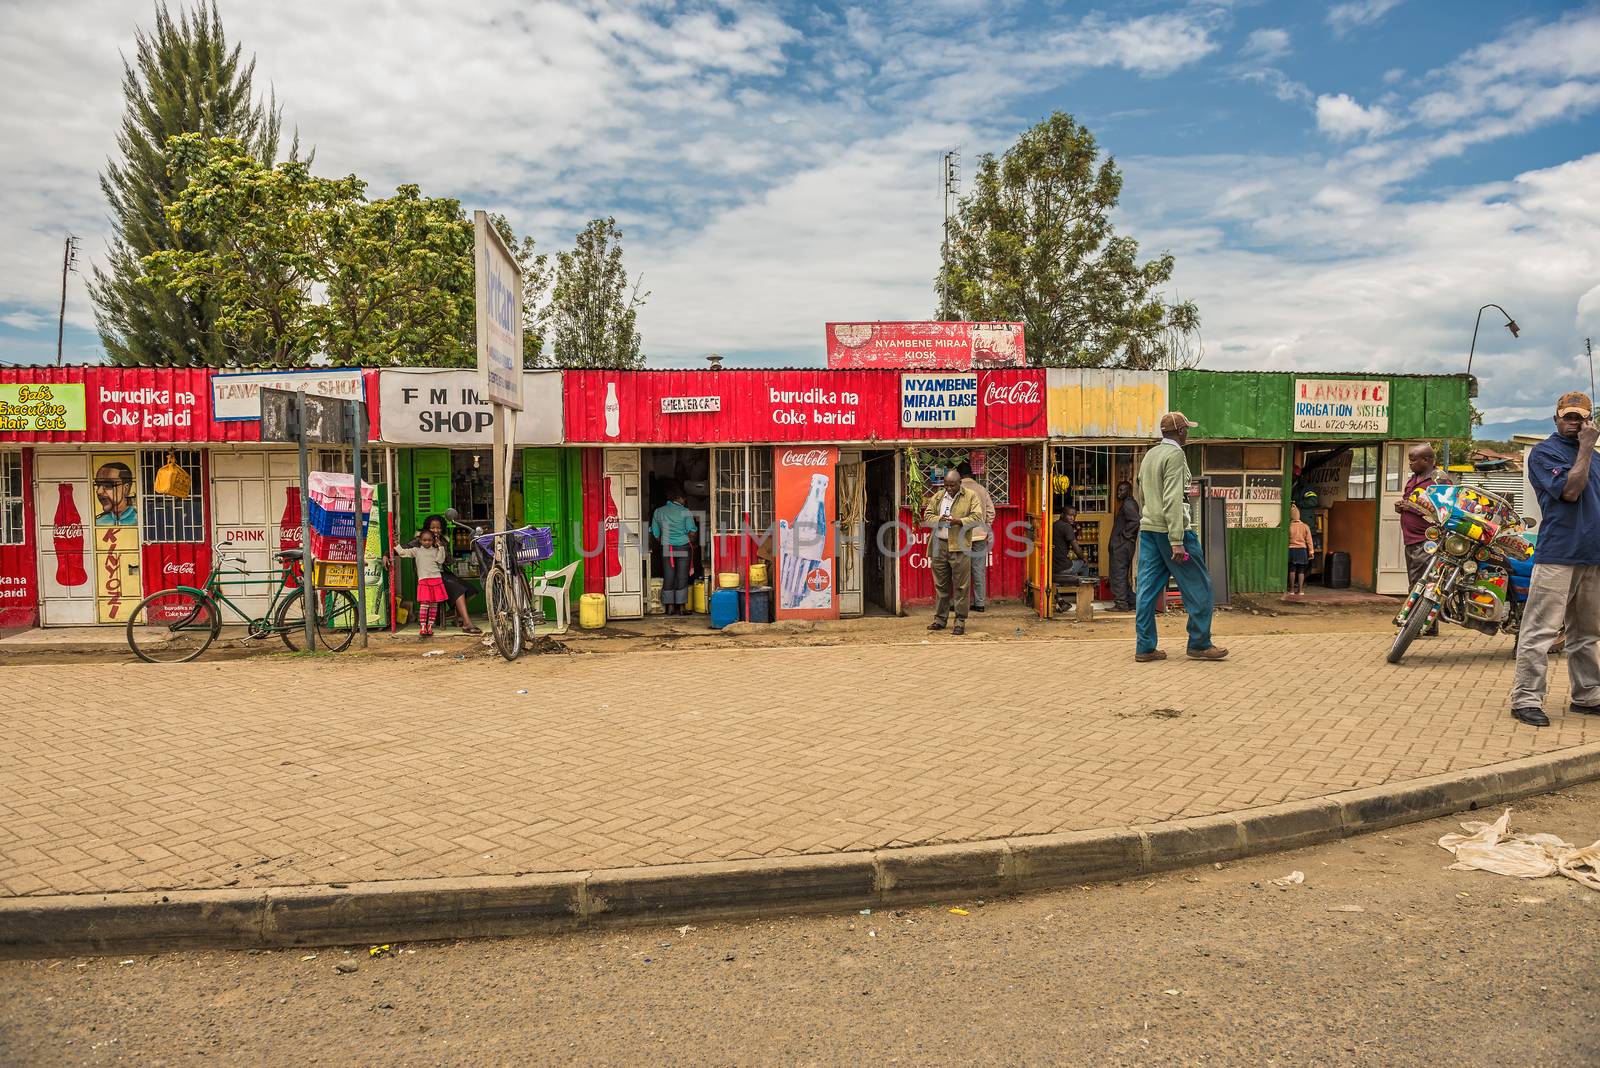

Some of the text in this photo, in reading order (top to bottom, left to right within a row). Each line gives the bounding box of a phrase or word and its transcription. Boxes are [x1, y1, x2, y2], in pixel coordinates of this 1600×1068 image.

[875, 339, 968, 348] NYAMBENE MIRAA
[905, 351, 936, 360] KIOSK
[317, 379, 361, 395] SHOP
[905, 378, 977, 392] NYAMBENE
[983, 380, 1041, 406] Coca-Cola
[100, 386, 195, 406] burudika na
[401, 388, 418, 404] F
[430, 389, 447, 404] M
[770, 388, 859, 405] burudika na
[903, 393, 977, 408] MIRAA BASE
[0, 416, 66, 429] Hair Cut
[102, 408, 139, 426] Coke
[419, 411, 494, 433] SHOP
[772, 409, 855, 425] Coke baridi
[914, 410, 956, 421] MIRITI
[781, 449, 829, 467] Coca-Cola
[226, 530, 265, 541] DRINK
